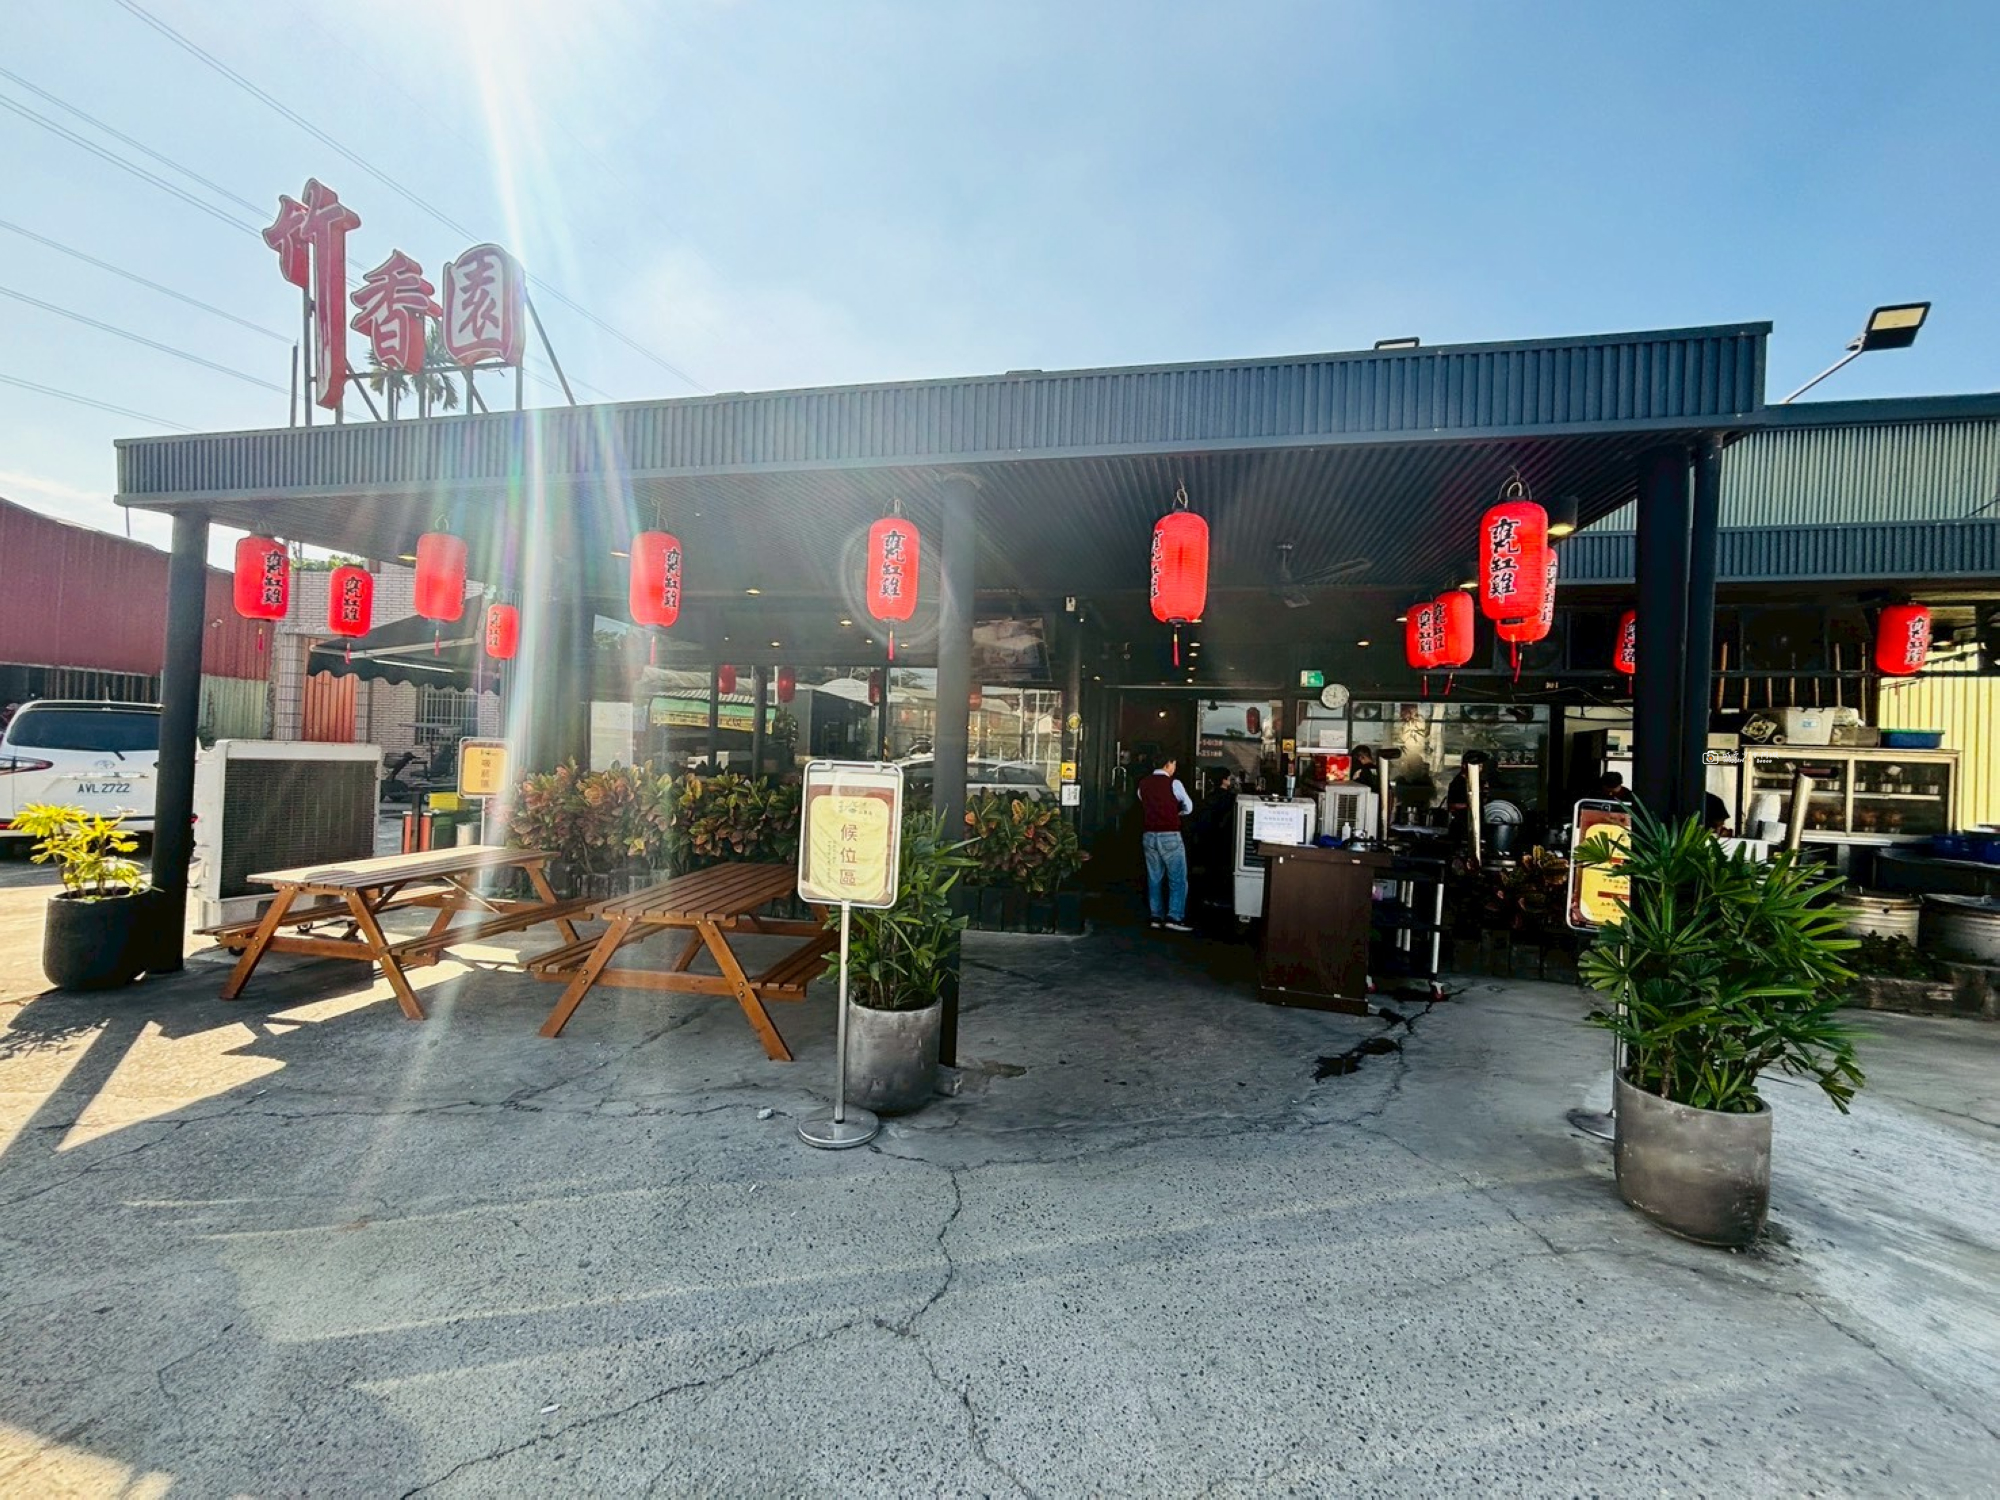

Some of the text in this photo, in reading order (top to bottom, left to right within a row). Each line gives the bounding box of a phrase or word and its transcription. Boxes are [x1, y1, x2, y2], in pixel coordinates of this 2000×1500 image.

[262, 178, 524, 409] 竹香園
[263, 550, 284, 605] 甕缸雞
[663, 548, 680, 608] 甕缸雞
[880, 530, 906, 597] 甕缸雞
[1489, 517, 1521, 599] 甕缸雞
[343, 576, 363, 621] 甕缸雞
[101, 783, 130, 793] 2722
[839, 823, 859, 887] 候位區
